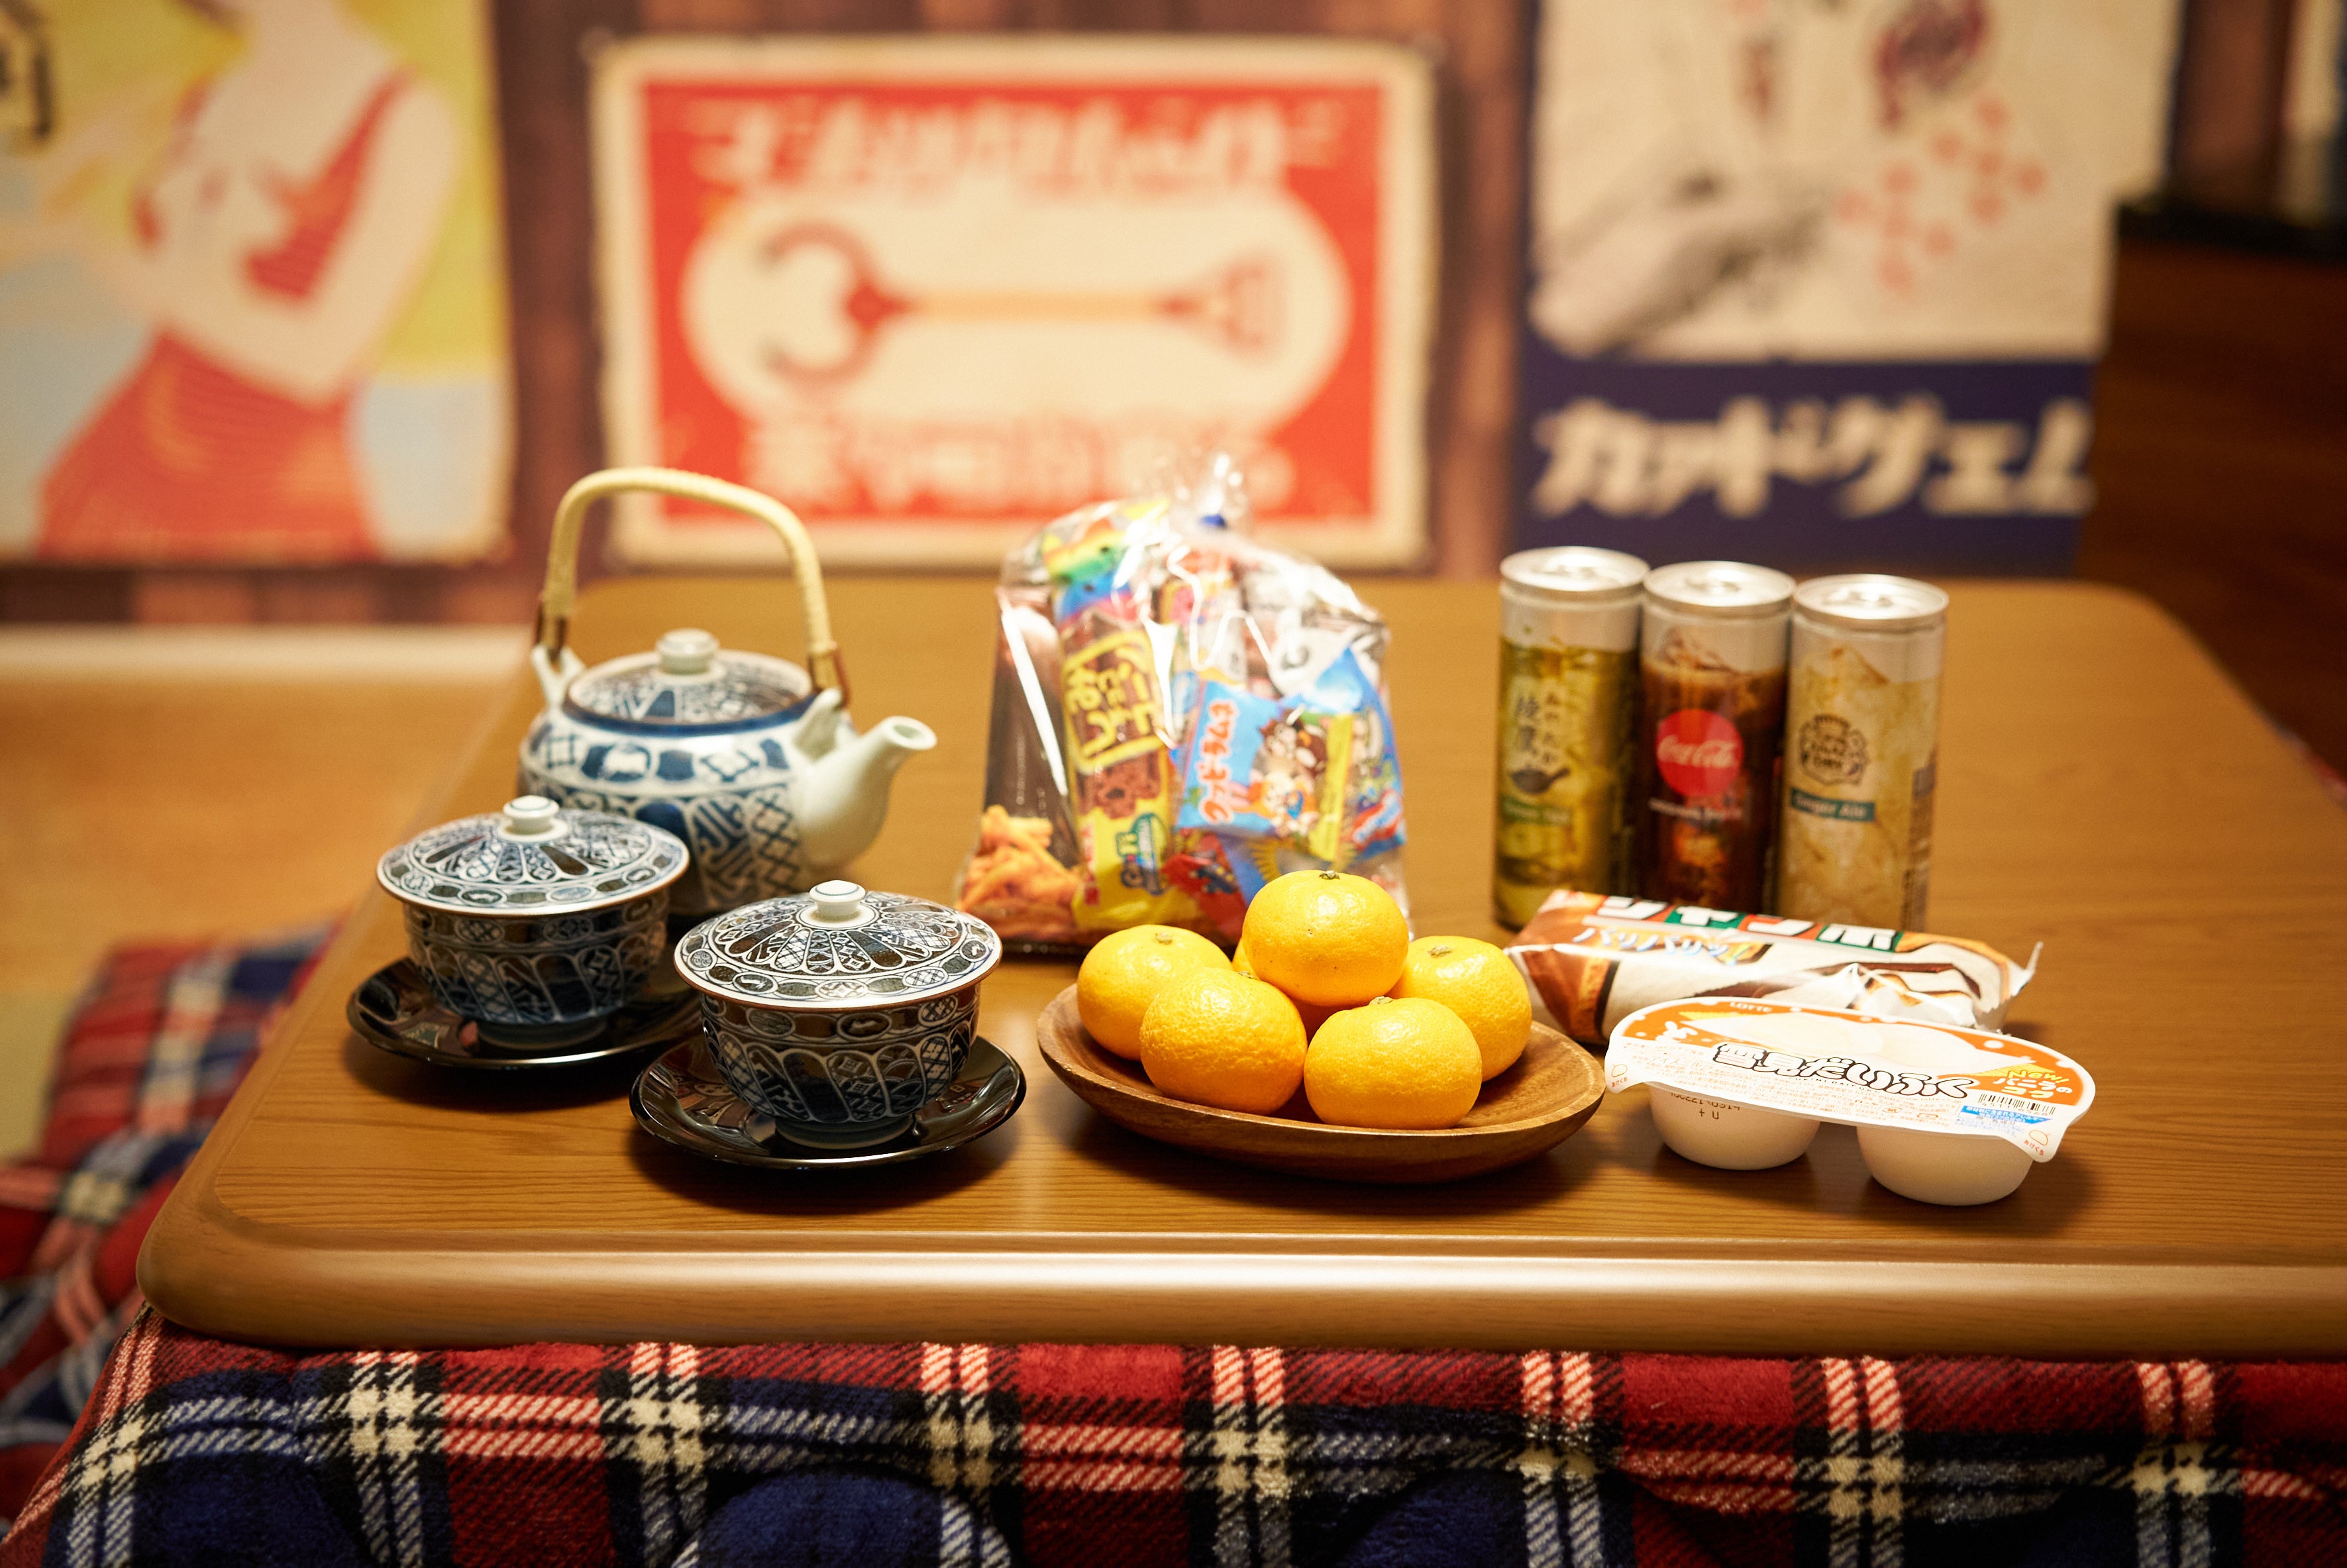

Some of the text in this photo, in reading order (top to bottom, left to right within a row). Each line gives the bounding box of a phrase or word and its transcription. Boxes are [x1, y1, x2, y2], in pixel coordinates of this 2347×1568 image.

[1657, 735, 1737, 768] Coca-Cola
[1730, 1002, 1773, 1013] LOTTE
[1712, 1042, 1974, 1098] 雪見だいふく
[2008, 1069, 2069, 1083] New!
[1993, 1078, 2073, 1094] バニラの
[2001, 1086, 2054, 1098] コク
